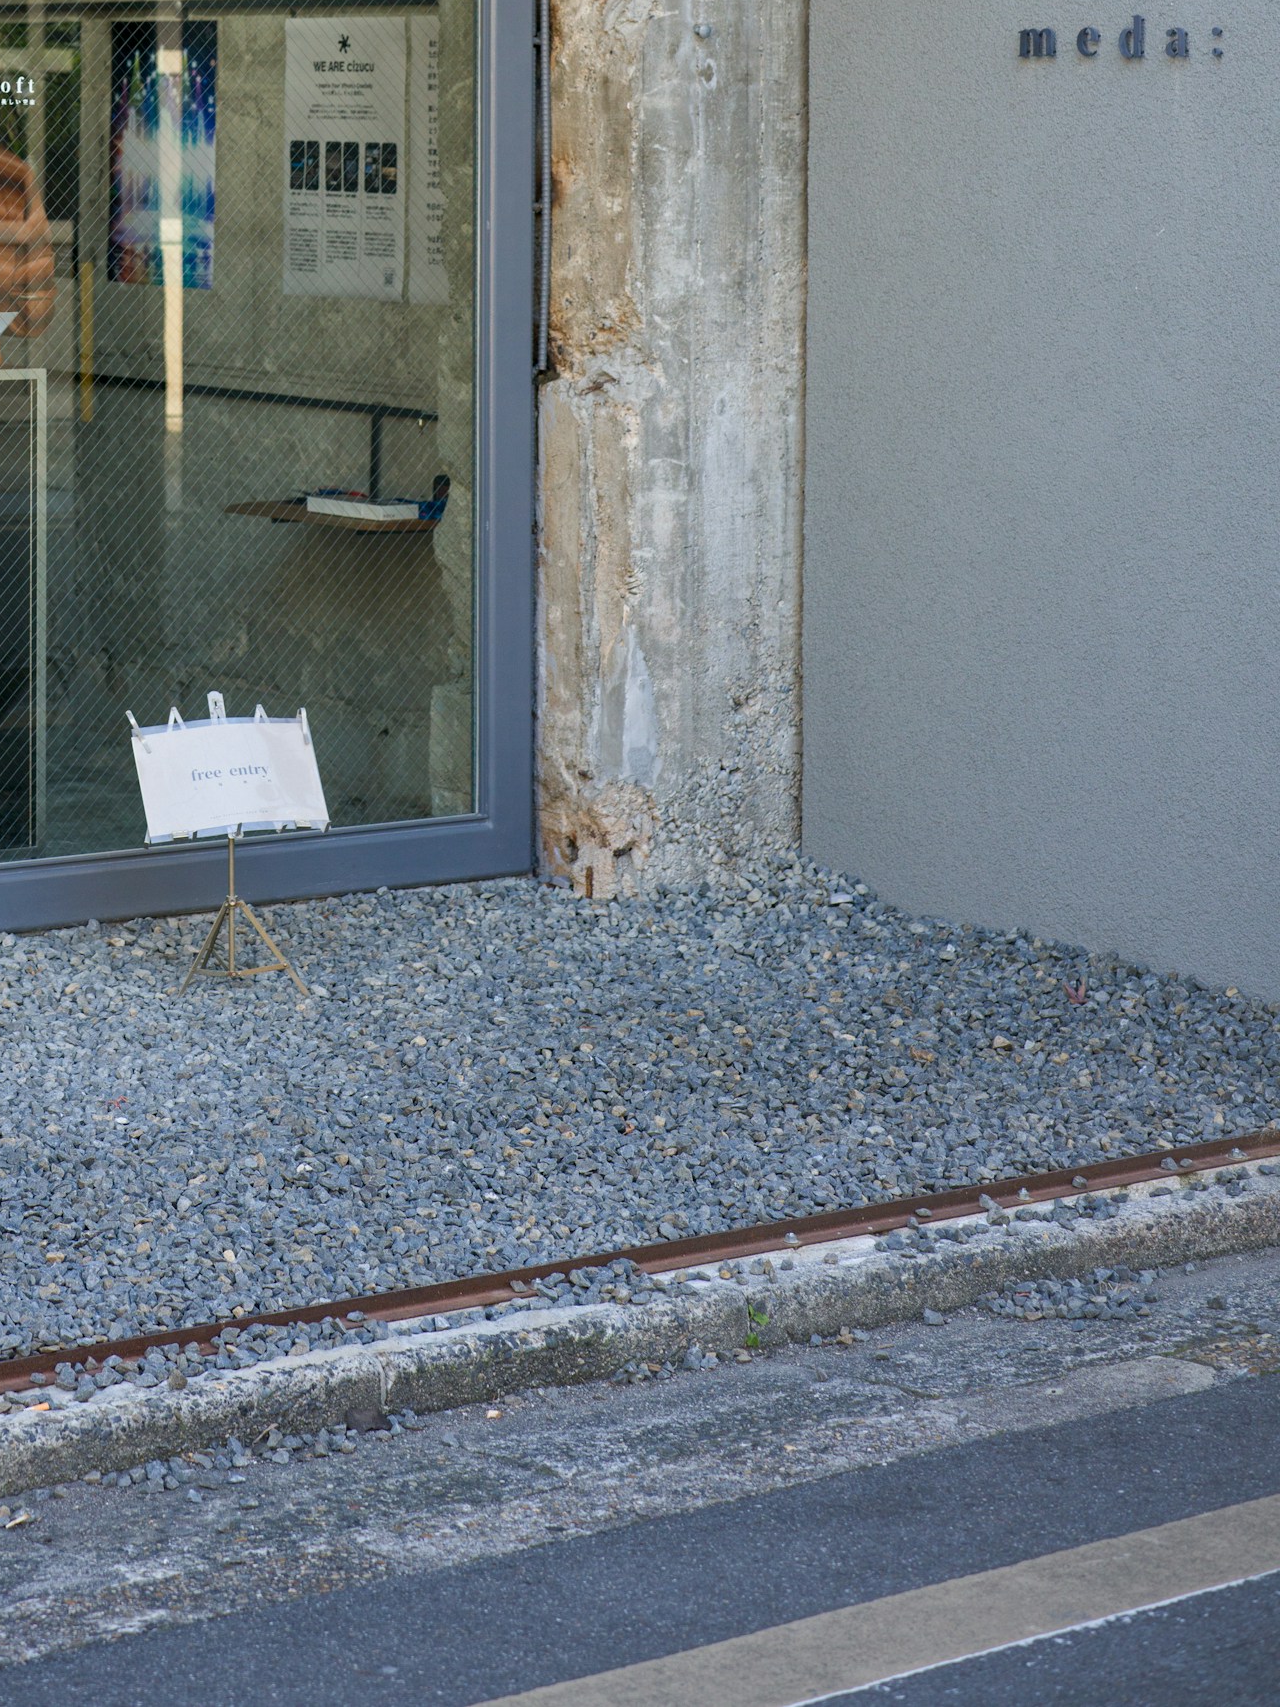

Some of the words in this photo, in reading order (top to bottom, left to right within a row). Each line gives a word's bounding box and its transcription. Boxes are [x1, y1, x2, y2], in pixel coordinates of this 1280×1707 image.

[1018, 14, 1224, 58] meda:
[313, 61, 326, 72] WE
[328, 61, 345, 72] ARE
[192, 769, 221, 781] free
[230, 765, 268, 777] entry
